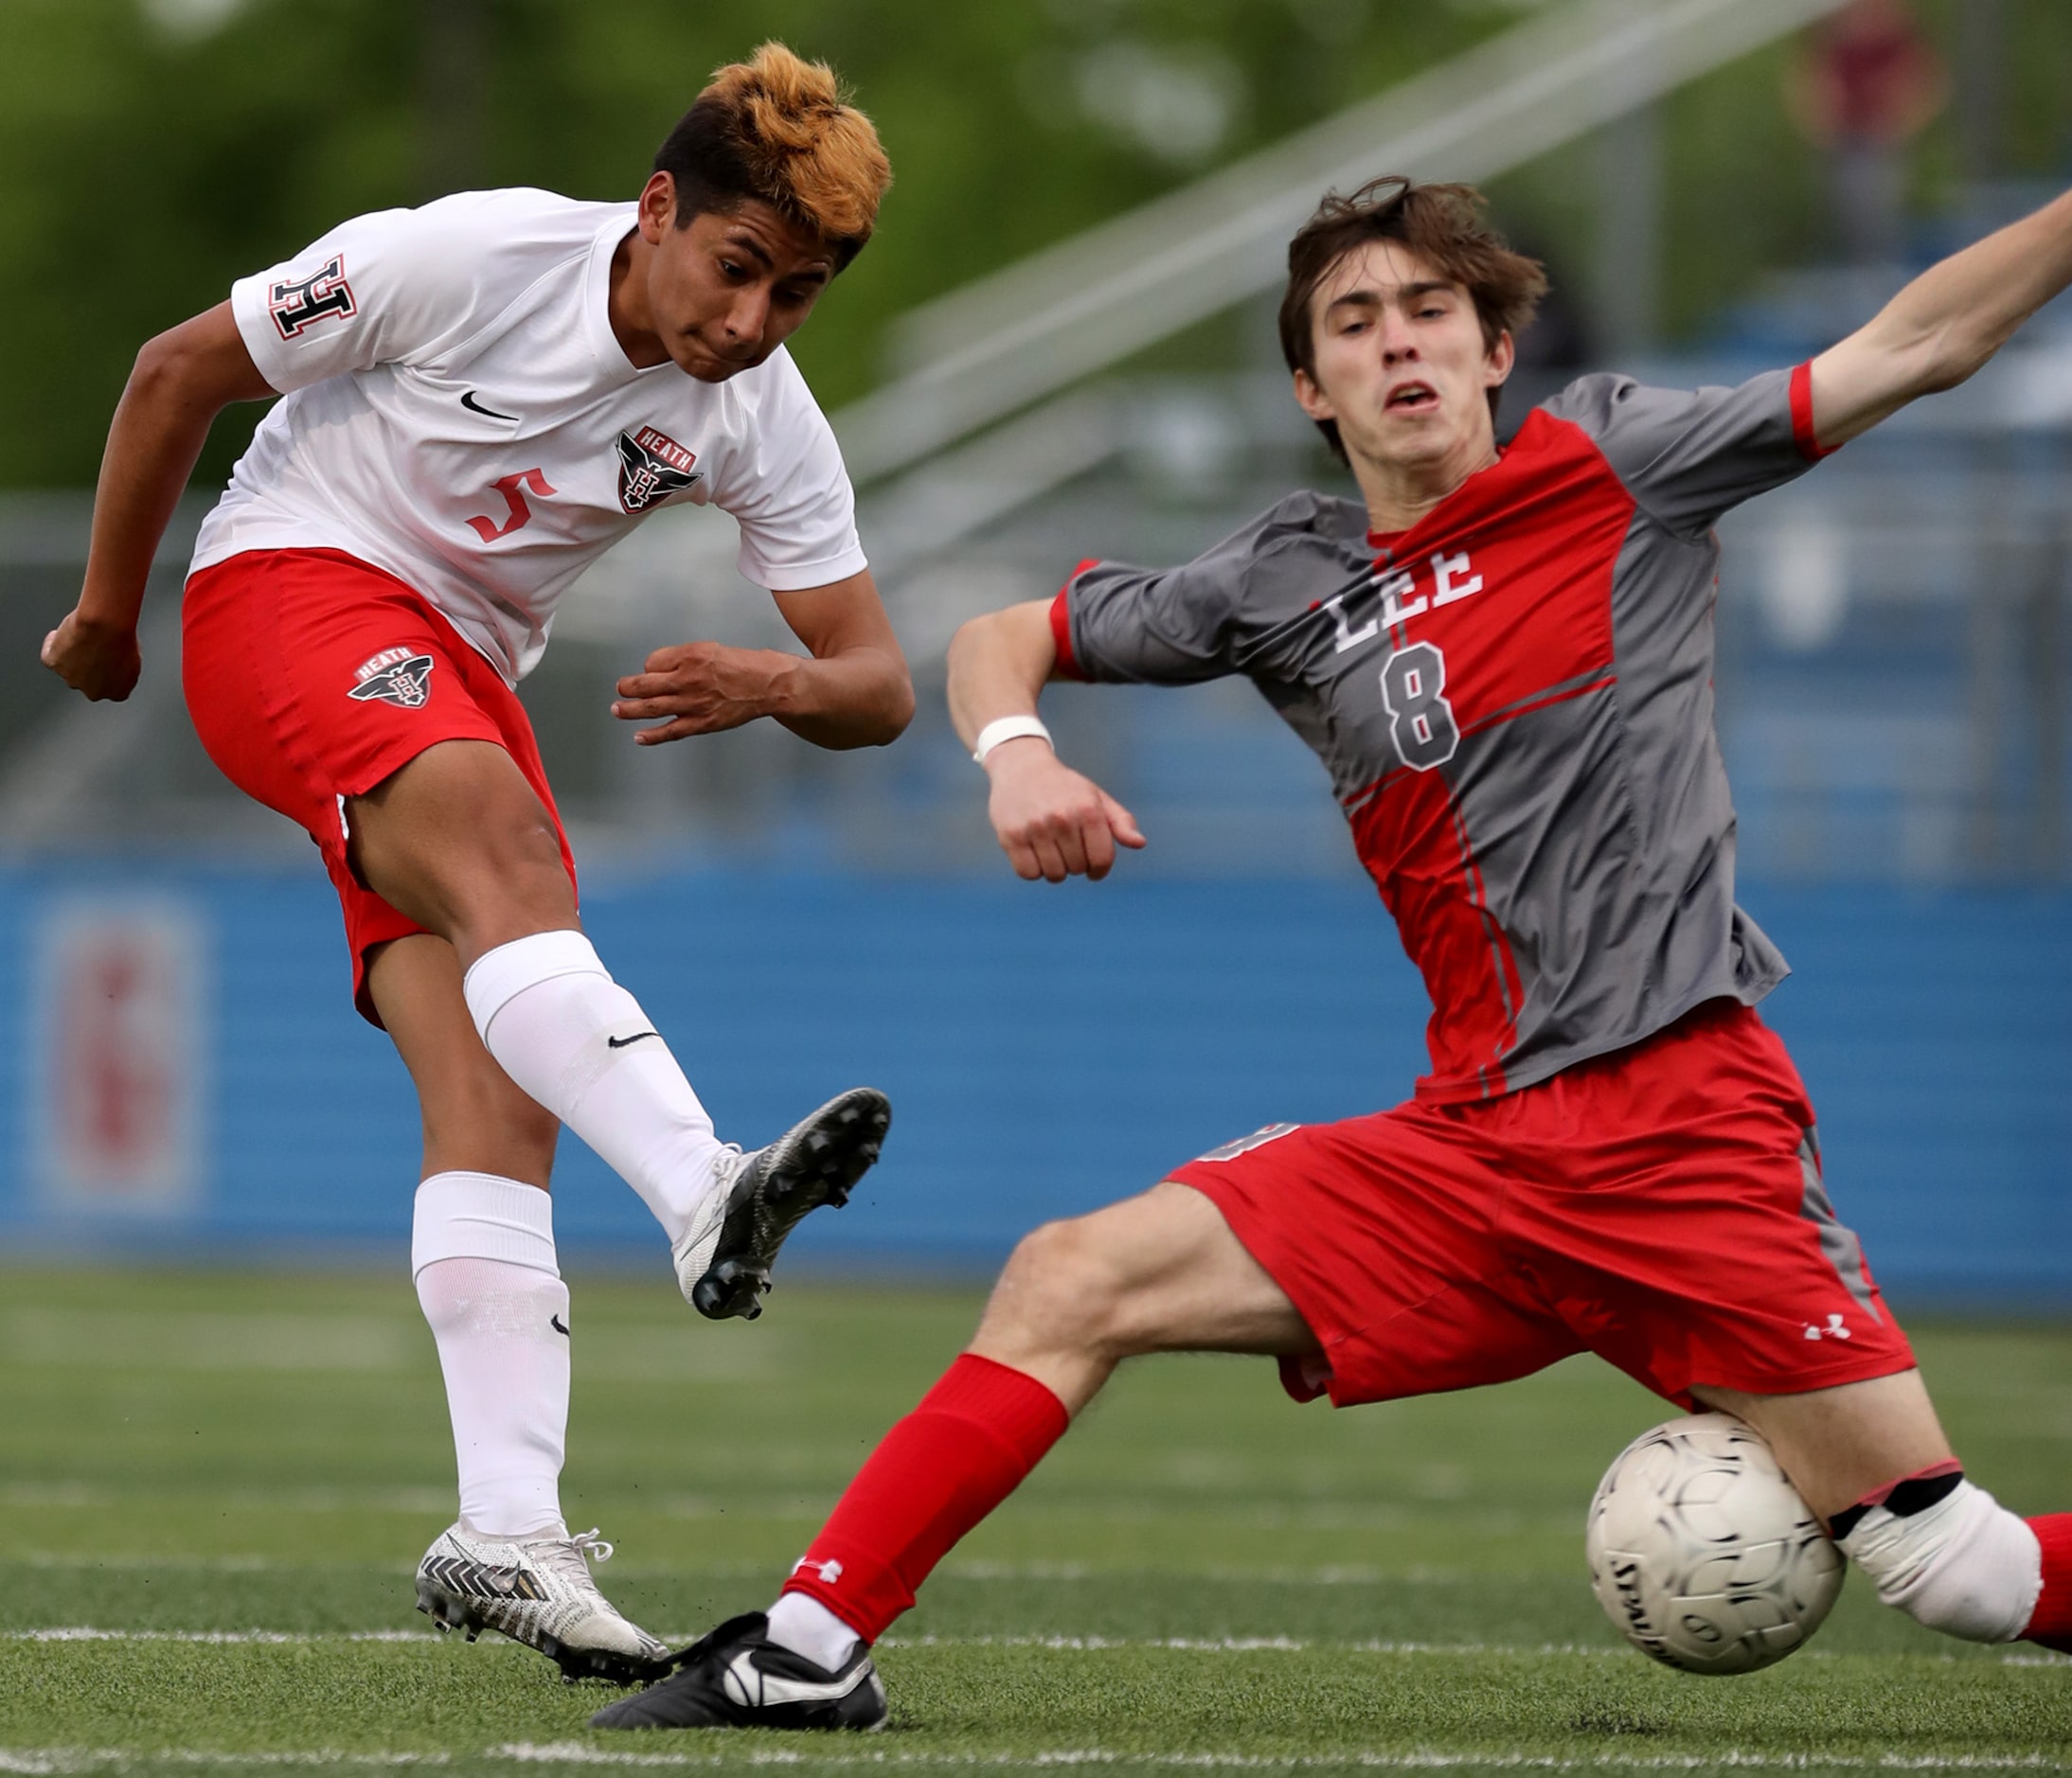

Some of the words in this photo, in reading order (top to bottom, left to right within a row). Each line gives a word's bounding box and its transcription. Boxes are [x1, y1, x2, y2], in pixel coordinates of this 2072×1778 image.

[269, 253, 357, 341] H
[627, 467, 660, 502] H
[639, 429, 692, 471] HEATH
[465, 468, 558, 542] 5
[1322, 551, 1483, 654] LEE
[357, 646, 414, 680] HEATH
[1380, 639, 1461, 773] 8
